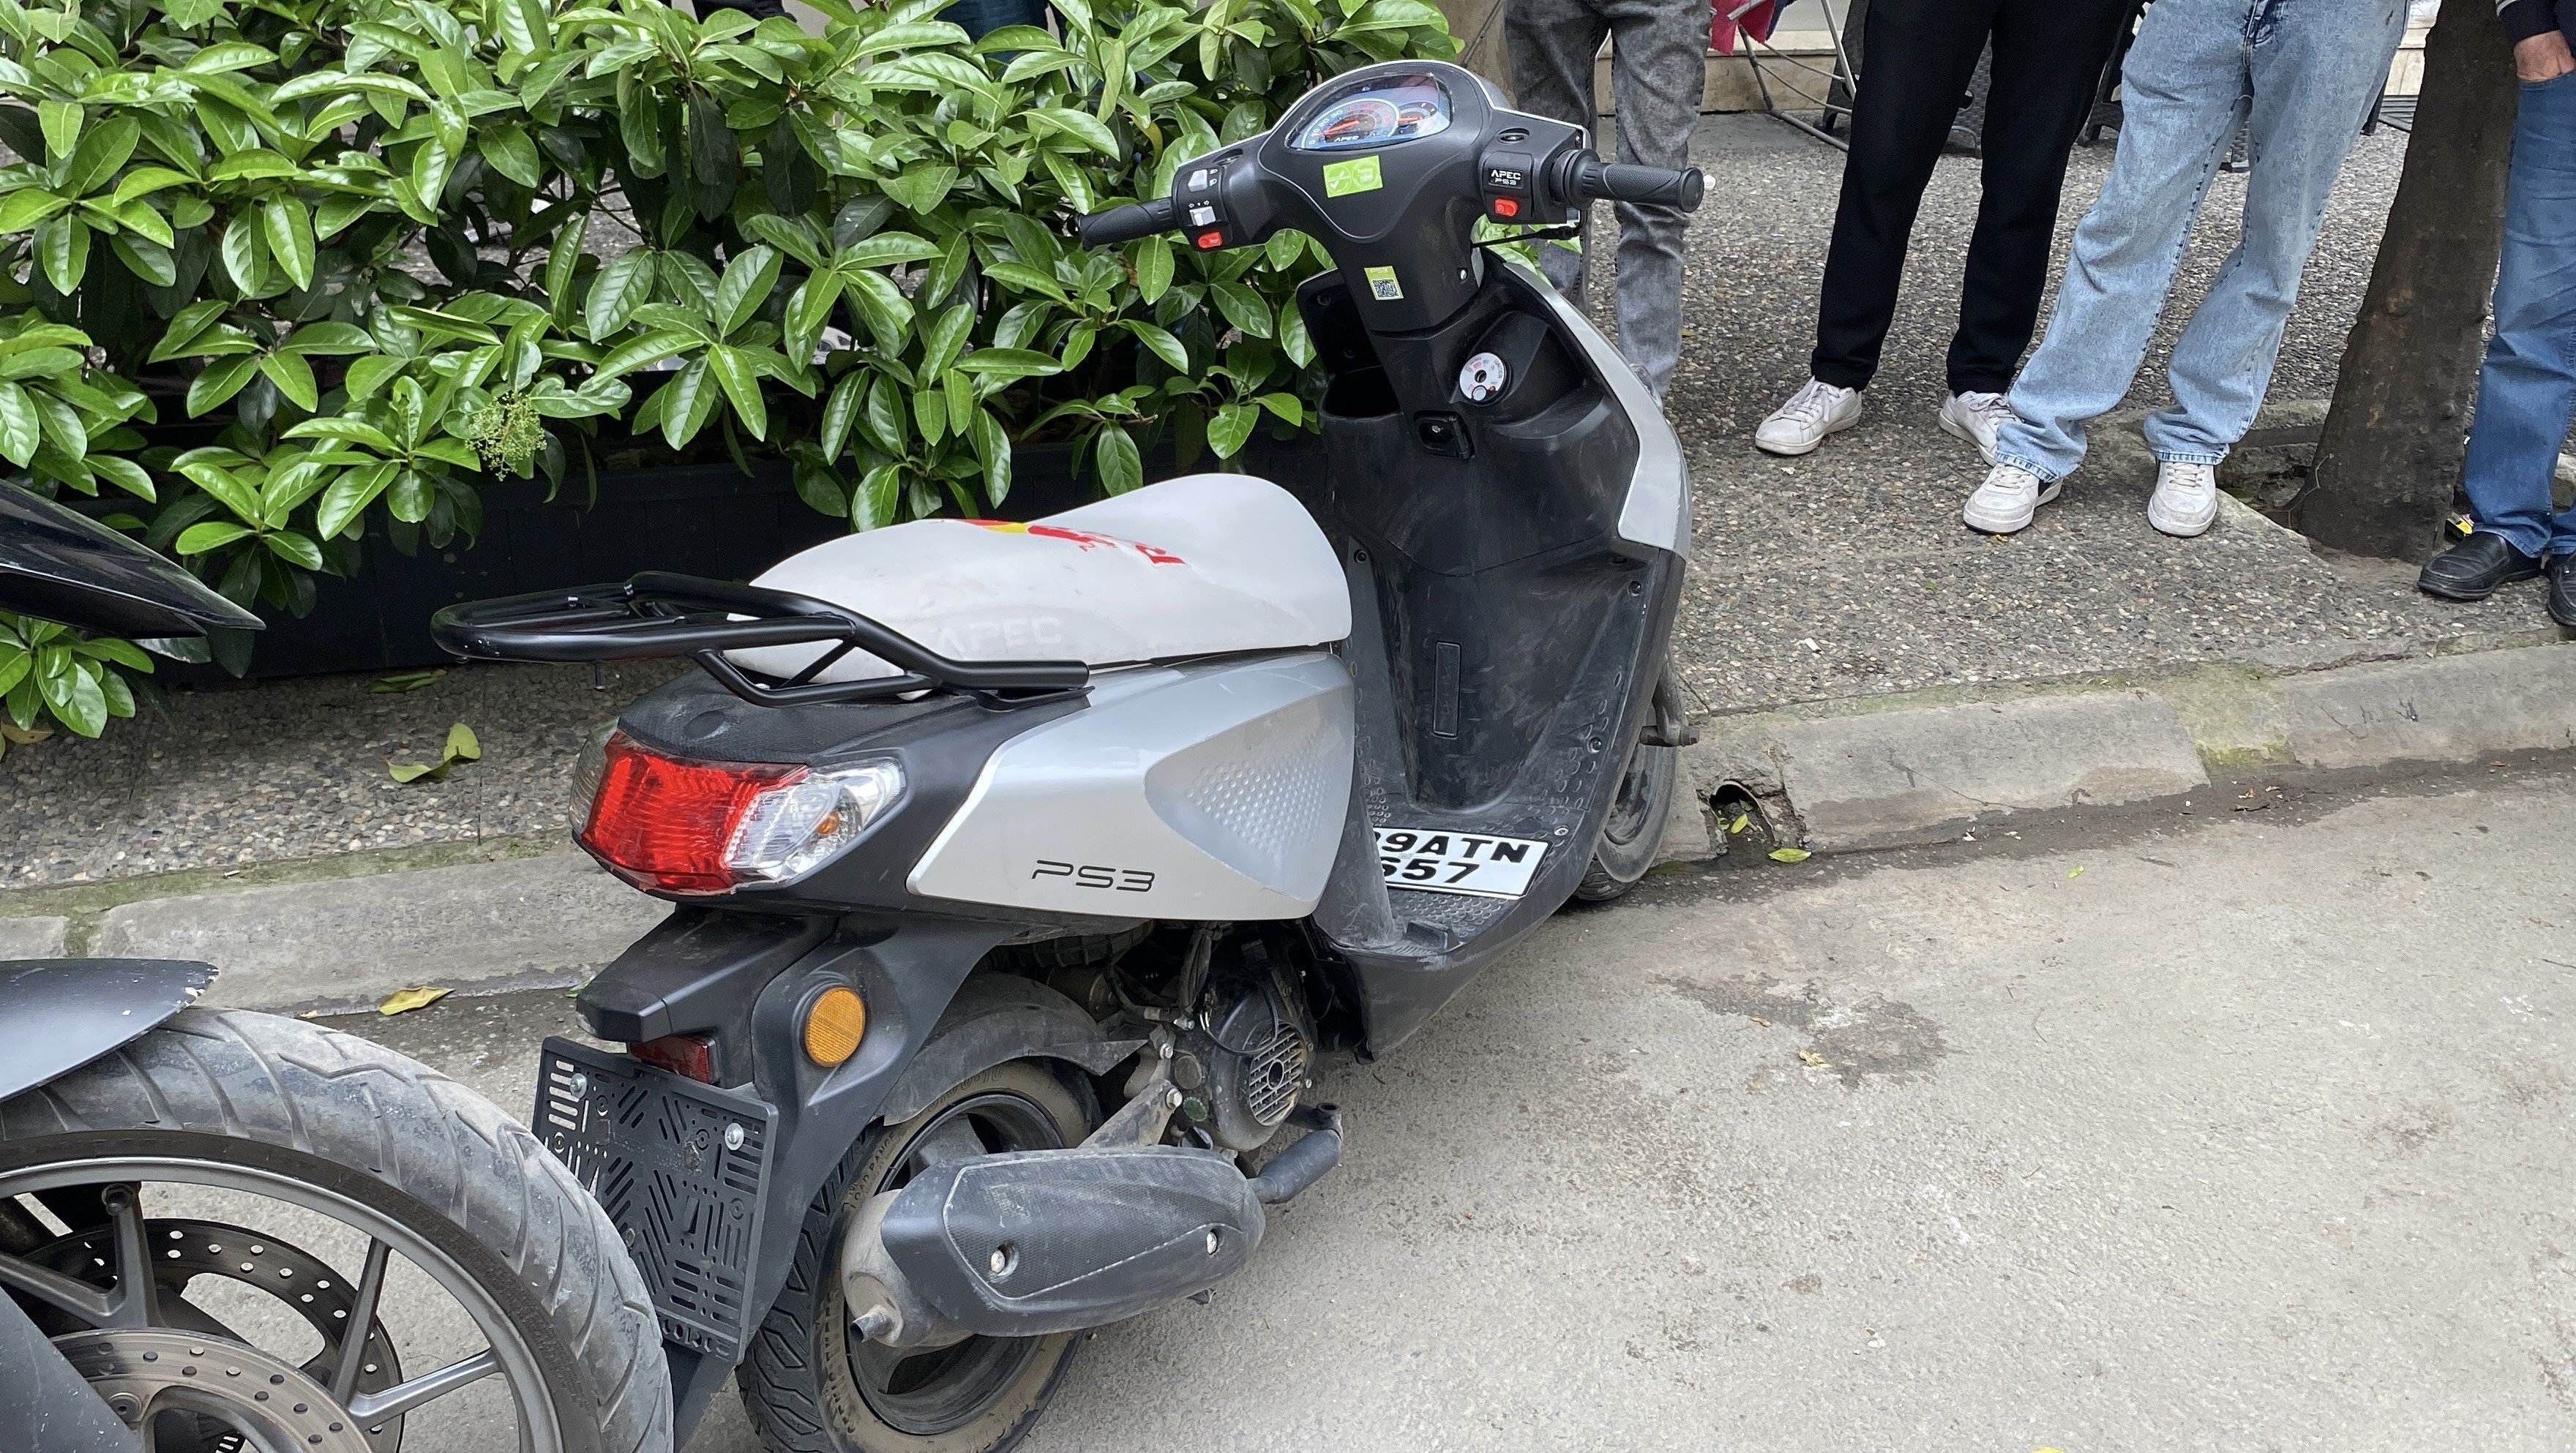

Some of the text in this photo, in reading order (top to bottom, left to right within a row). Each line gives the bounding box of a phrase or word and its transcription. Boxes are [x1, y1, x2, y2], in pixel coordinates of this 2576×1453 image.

[1491, 169, 1521, 181] APEC
[1494, 177, 1517, 186] PS3
[935, 616, 1062, 660] APEC
[1031, 859, 1156, 893] PS3
